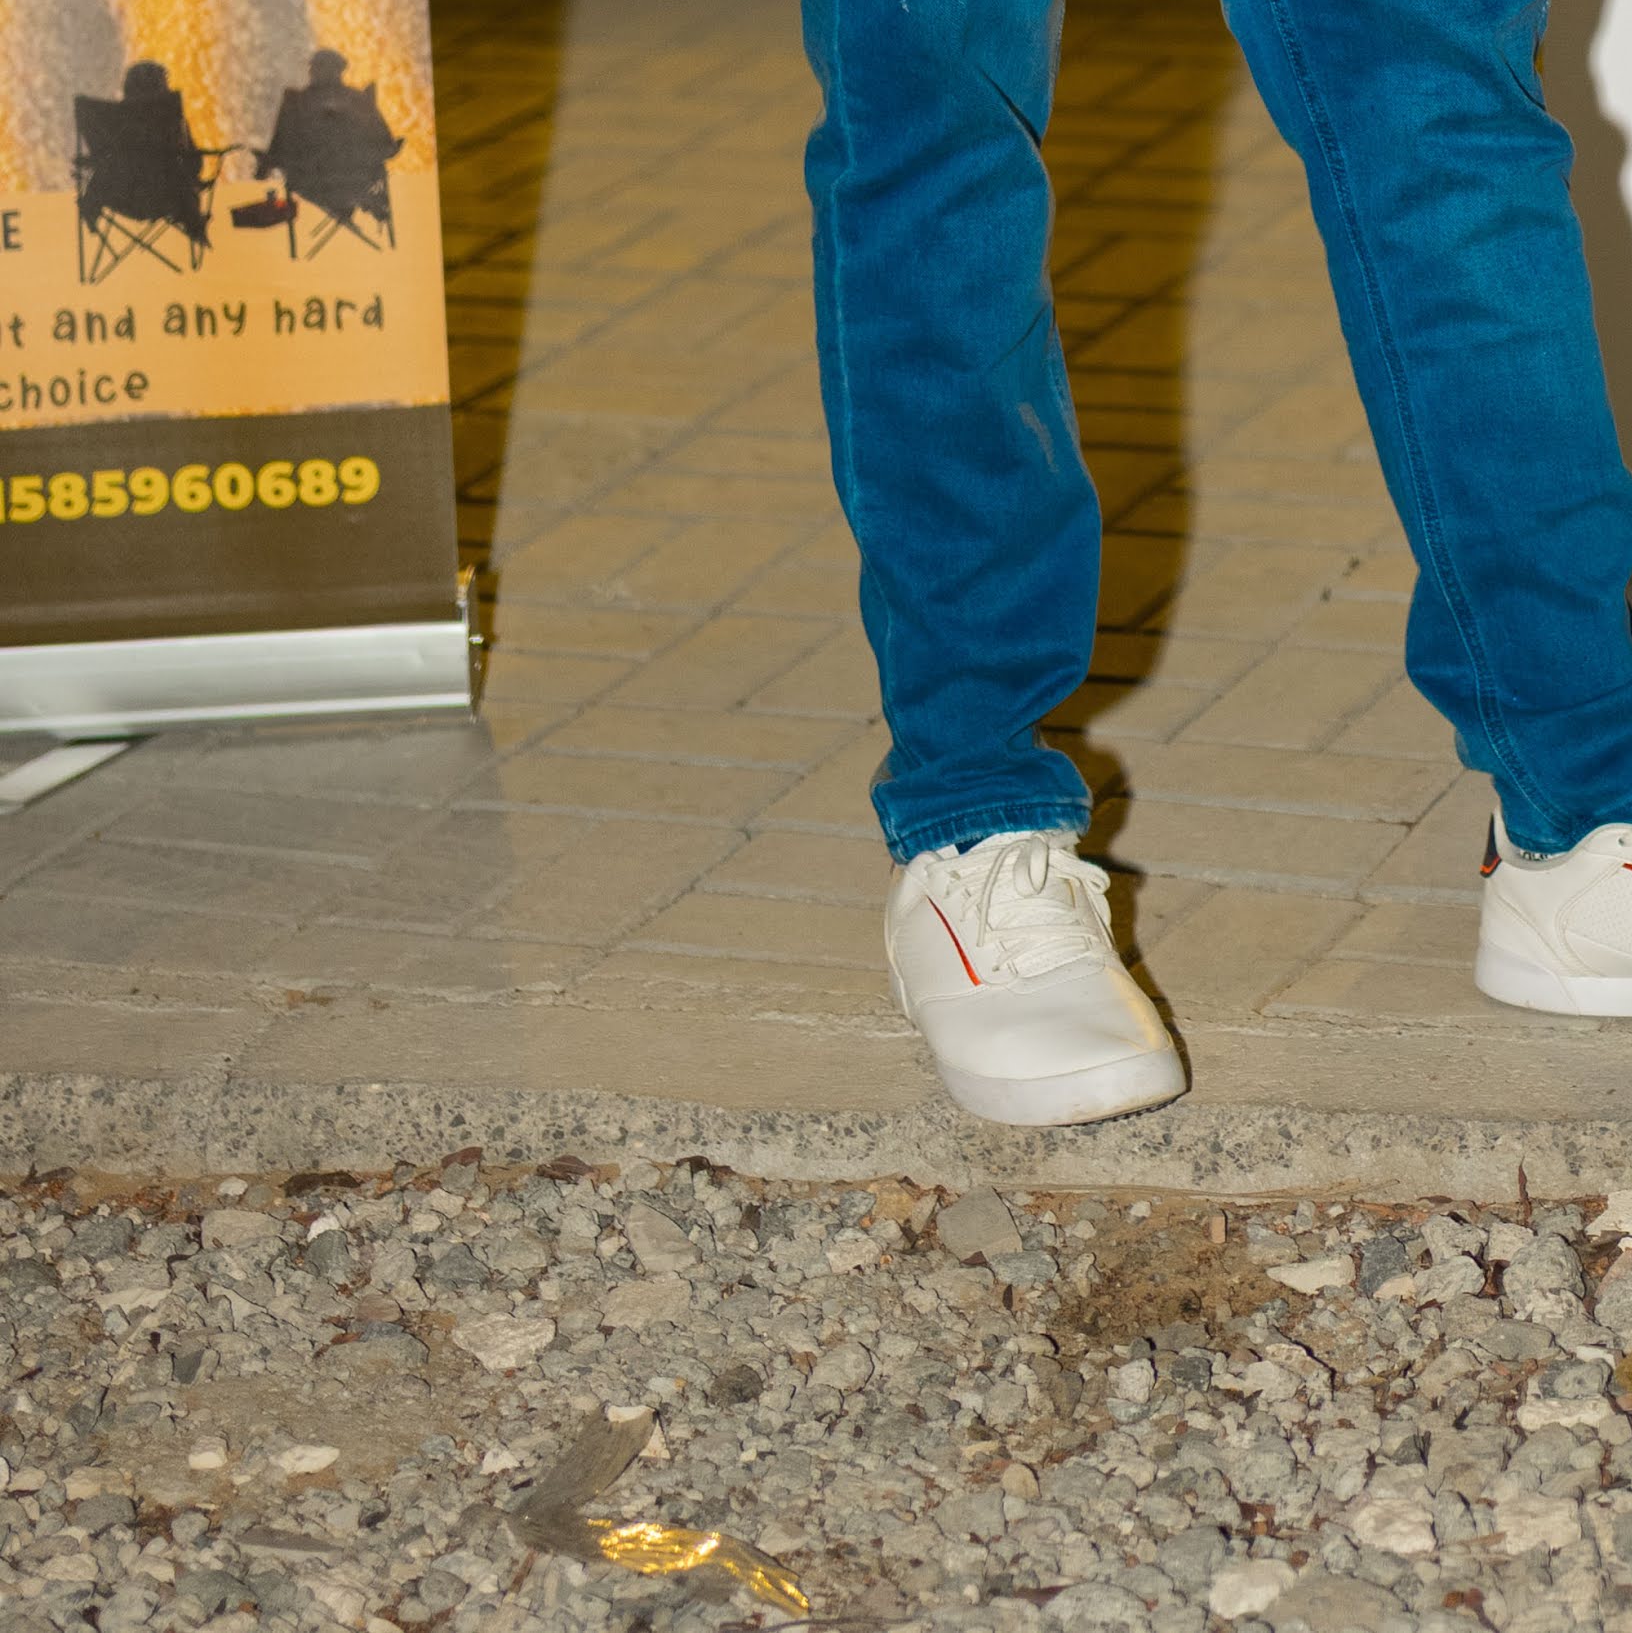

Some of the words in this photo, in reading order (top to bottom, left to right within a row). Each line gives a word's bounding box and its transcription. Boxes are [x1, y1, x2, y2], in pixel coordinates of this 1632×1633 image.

[52, 305, 137, 342] and
[163, 301, 247, 337] any
[273, 294, 385, 335] hard
